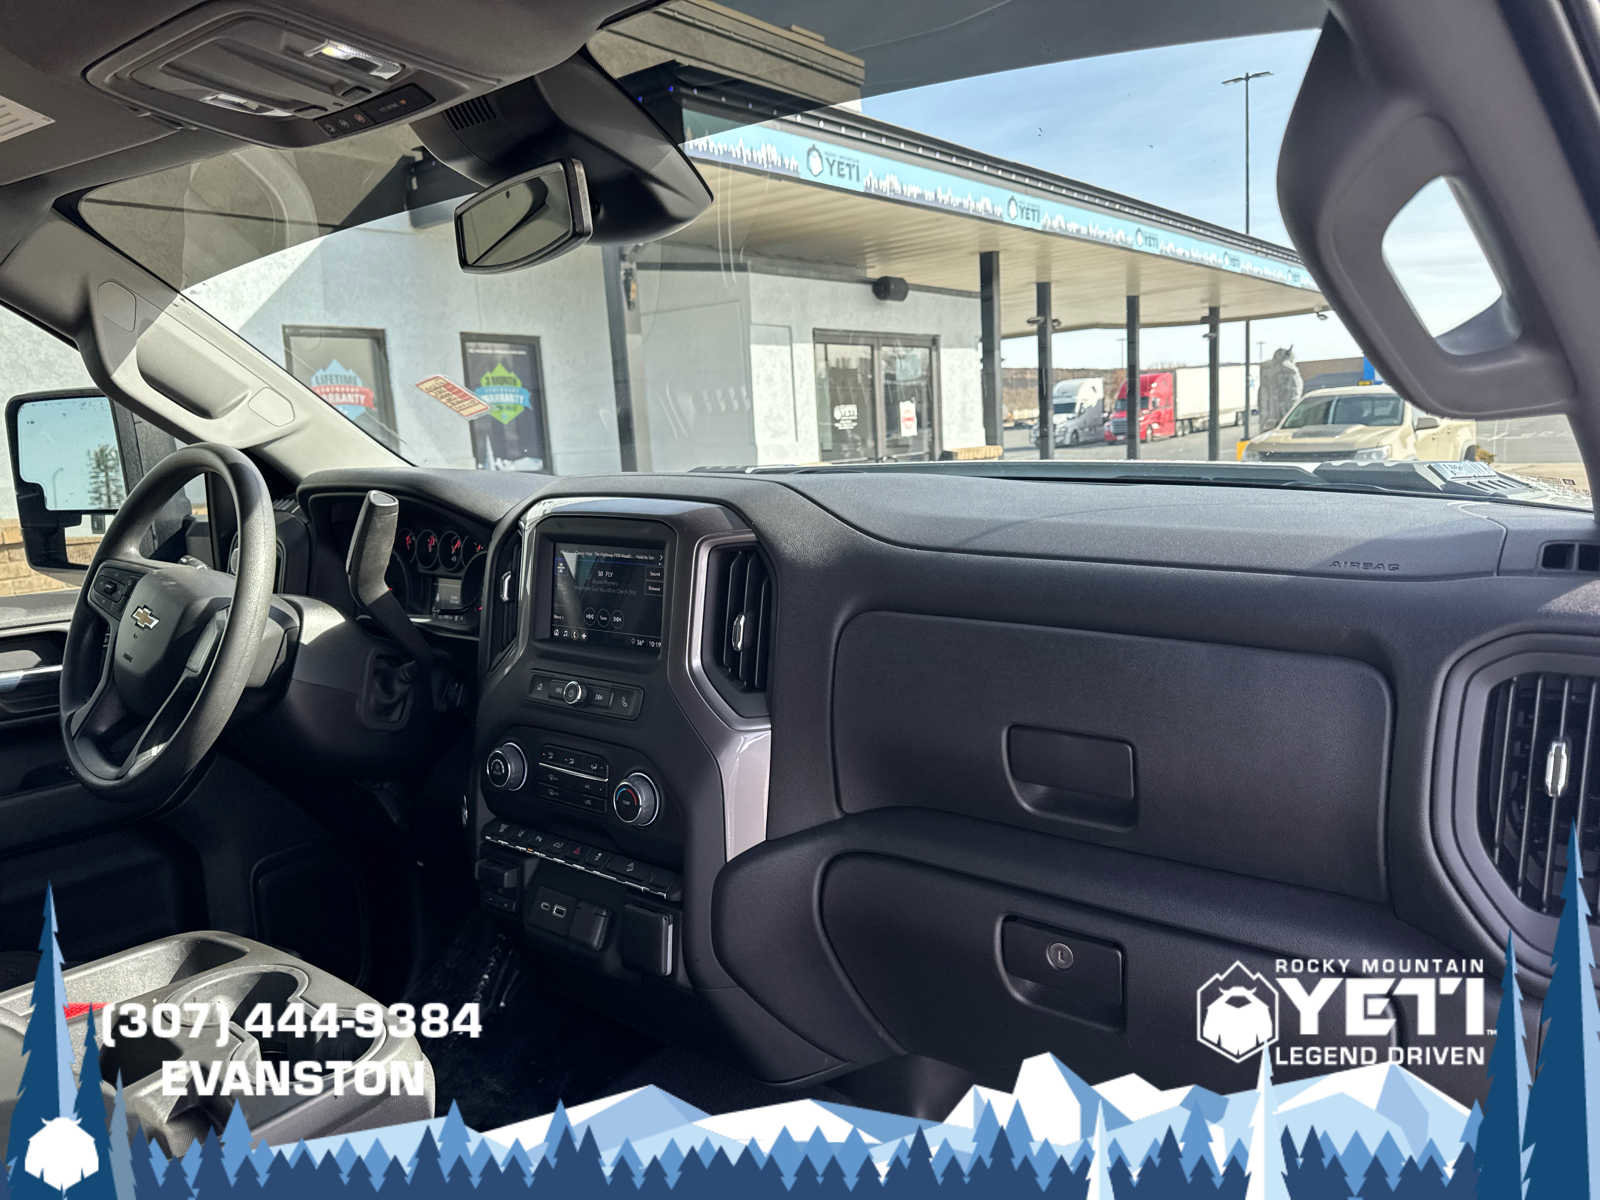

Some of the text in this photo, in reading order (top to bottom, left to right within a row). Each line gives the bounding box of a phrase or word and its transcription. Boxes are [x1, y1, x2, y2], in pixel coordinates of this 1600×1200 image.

[825, 157, 860, 182] YETI
[1018, 205, 1041, 224] YETI
[1329, 560, 1400, 571] AIRBAG
